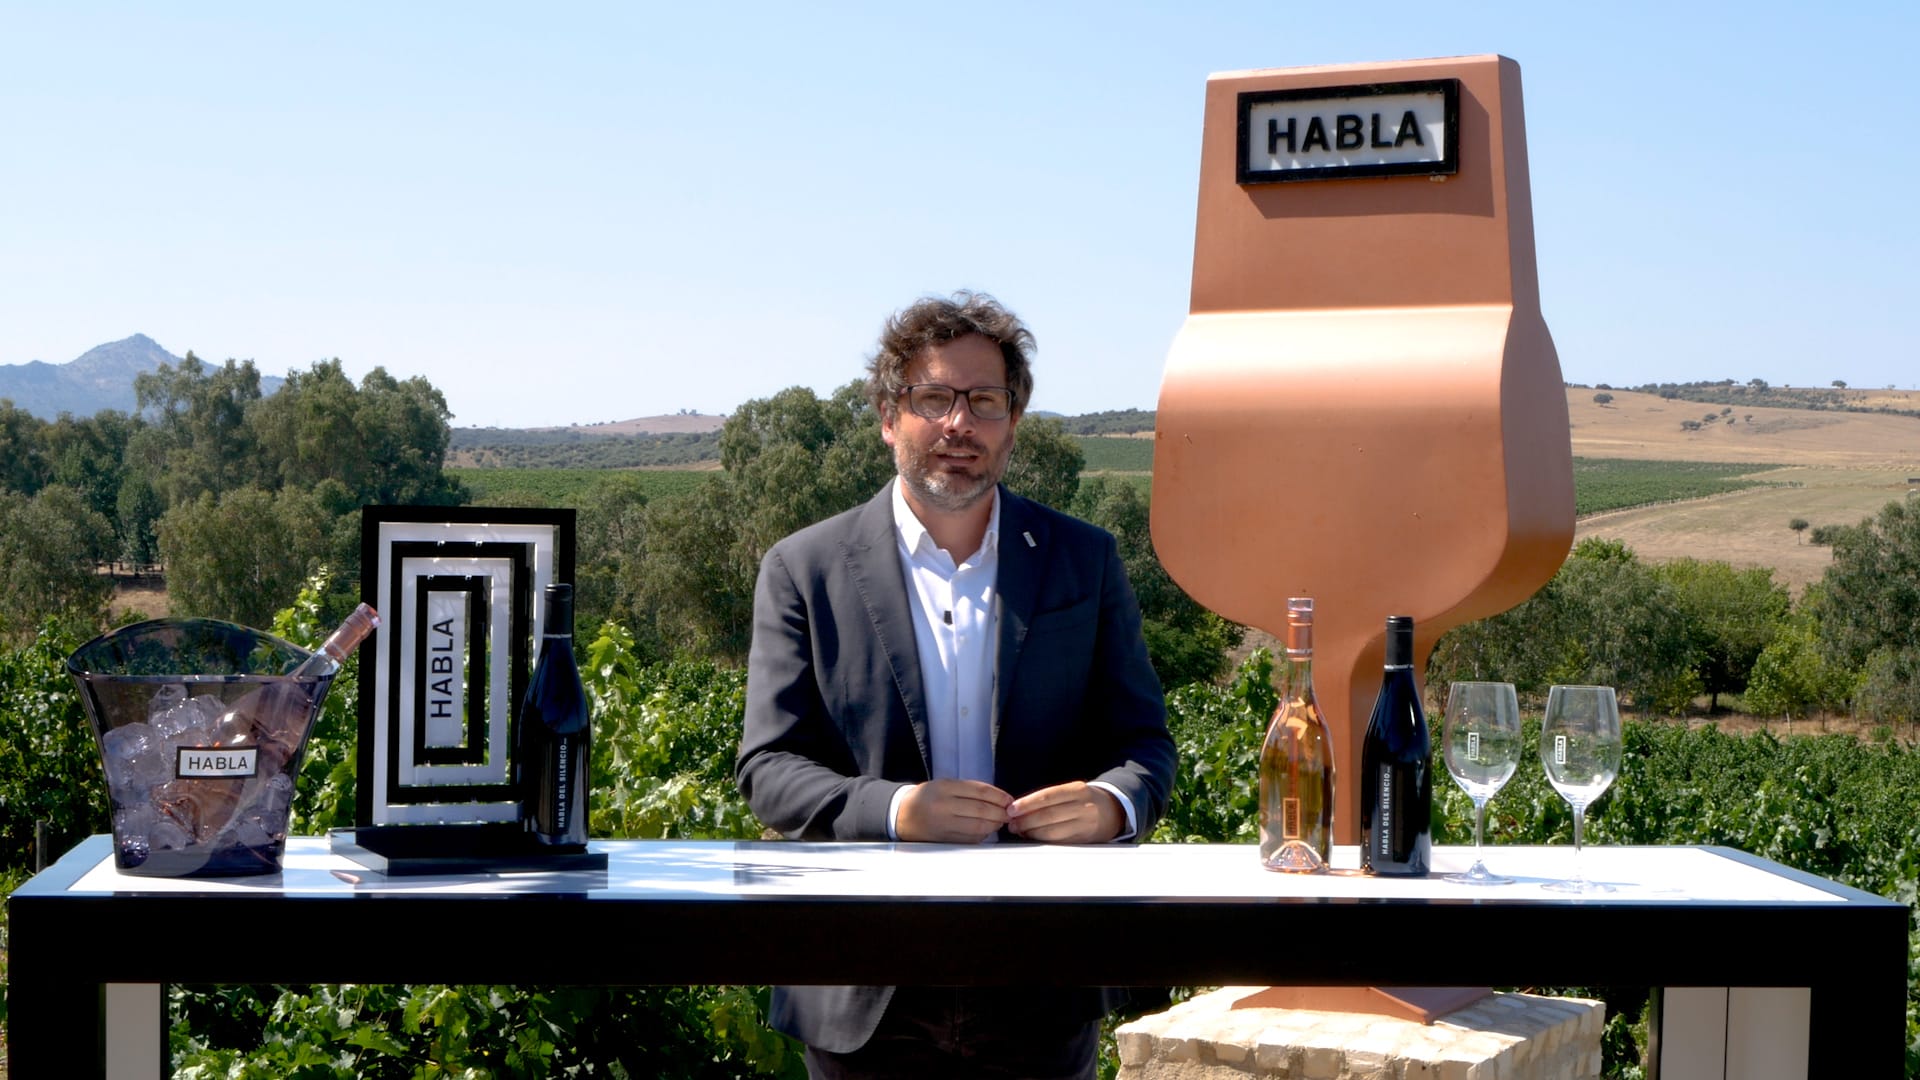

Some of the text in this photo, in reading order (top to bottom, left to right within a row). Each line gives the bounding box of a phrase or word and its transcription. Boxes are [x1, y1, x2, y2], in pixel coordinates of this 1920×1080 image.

[1268, 110, 1424, 154] HABLA
[430, 618, 454, 718] HABLA
[188, 756, 248, 770] HABLA
[558, 784, 566, 799] DEL
[558, 801, 566, 828] HABLA
